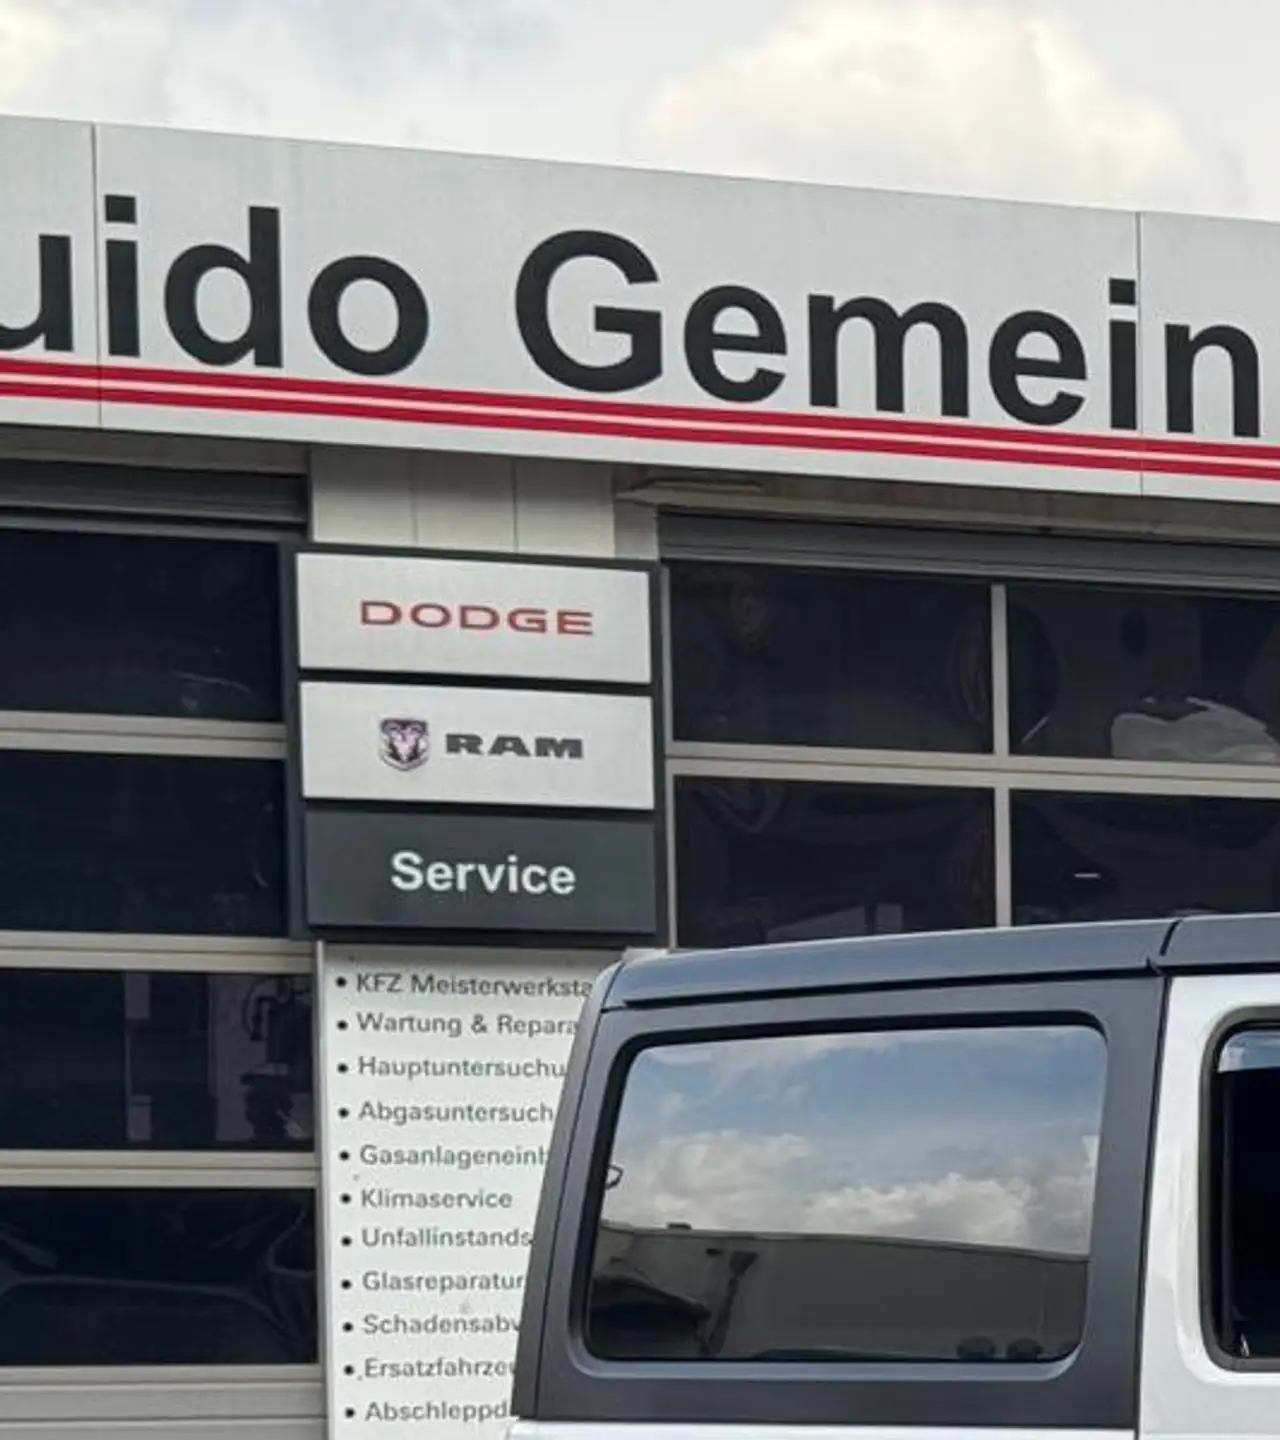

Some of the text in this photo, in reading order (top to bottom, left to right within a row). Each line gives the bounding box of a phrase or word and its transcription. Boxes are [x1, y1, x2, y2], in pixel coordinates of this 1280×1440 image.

[514, 228, 1261, 438] Gemein
[360, 599, 594, 636] DODGE
[445, 732, 584, 759] RAM
[390, 850, 576, 895] Service
[356, 973, 402, 994] KFZ
[356, 1011, 462, 1037] Wartung
[470, 1014, 488, 1034] &
[360, 1188, 513, 1209] Klimaservice
